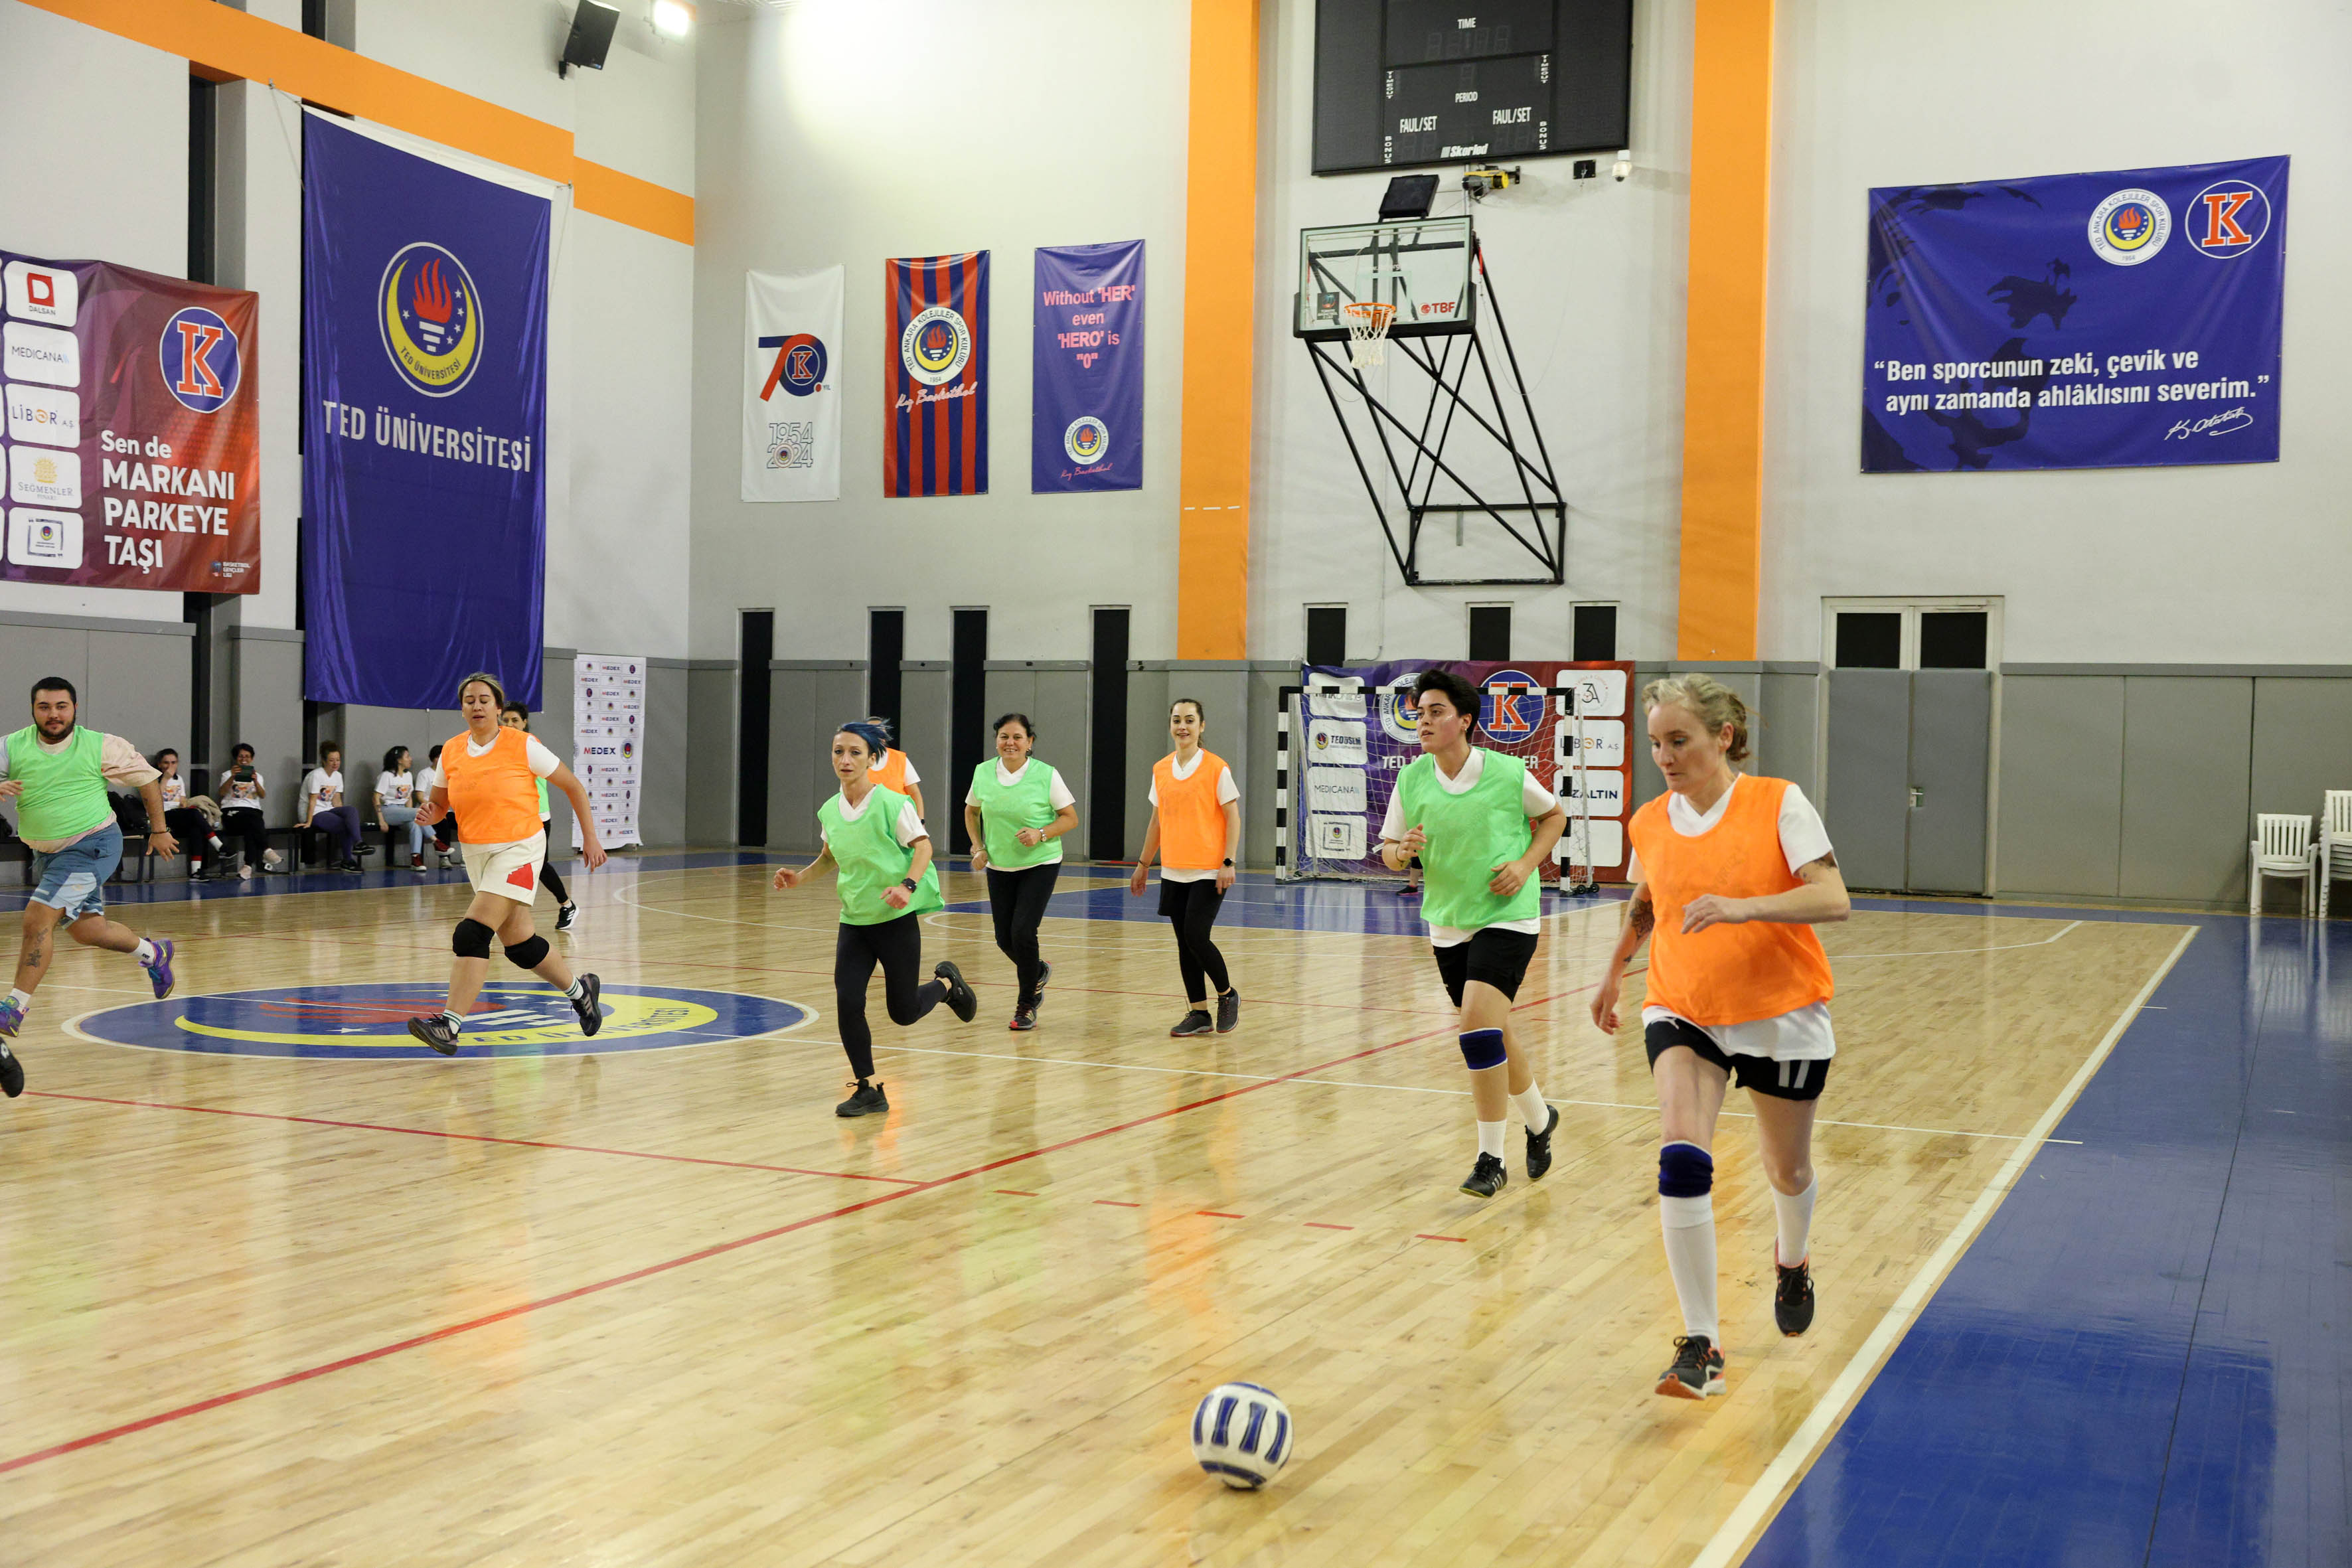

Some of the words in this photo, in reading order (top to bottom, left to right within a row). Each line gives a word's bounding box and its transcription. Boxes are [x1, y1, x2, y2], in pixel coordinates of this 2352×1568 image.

[1457, 17, 1476, 29] TIME
[1540, 54, 1549, 84] TIMEOUT
[1455, 92, 1478, 103] PERIOD
[1399, 116, 1438, 133] FAUL/SET
[1493, 107, 1531, 125] FAUL/SET
[2202, 191, 2253, 248] K
[1043, 289, 1095, 306] Without
[29, 305, 56, 315] DALSAN
[1432, 302, 1455, 314] TBF
[1072, 313, 1105, 326] even
[904, 324, 918, 353] ANKARA
[1107, 331, 1120, 345] is
[11, 346, 64, 363] MEDICANA
[177, 320, 224, 398] K
[401, 346, 414, 364] TED
[792, 351, 813, 379] K
[1932, 359, 2043, 384] sporcunun
[2049, 353, 2099, 377] zeki,
[2107, 349, 2167, 378] çevik
[2172, 351, 2199, 369] ve
[1886, 394, 1929, 416] aynı
[1934, 387, 2031, 410] zamanda
[2037, 383, 2150, 407] ahlâklısını
[323, 400, 366, 441] TED
[375, 406, 531, 472] ÜNİVERSİTESİ
[769, 422, 814, 444] 1954
[101, 430, 140, 455] Sen
[145, 435, 172, 459] de
[102, 458, 235, 500] MARKANI
[104, 497, 229, 536] PARKEYE
[104, 534, 163, 574] TAŞI
[1382, 755, 1406, 769] TED
[1314, 785, 1355, 794] MEDICANA
